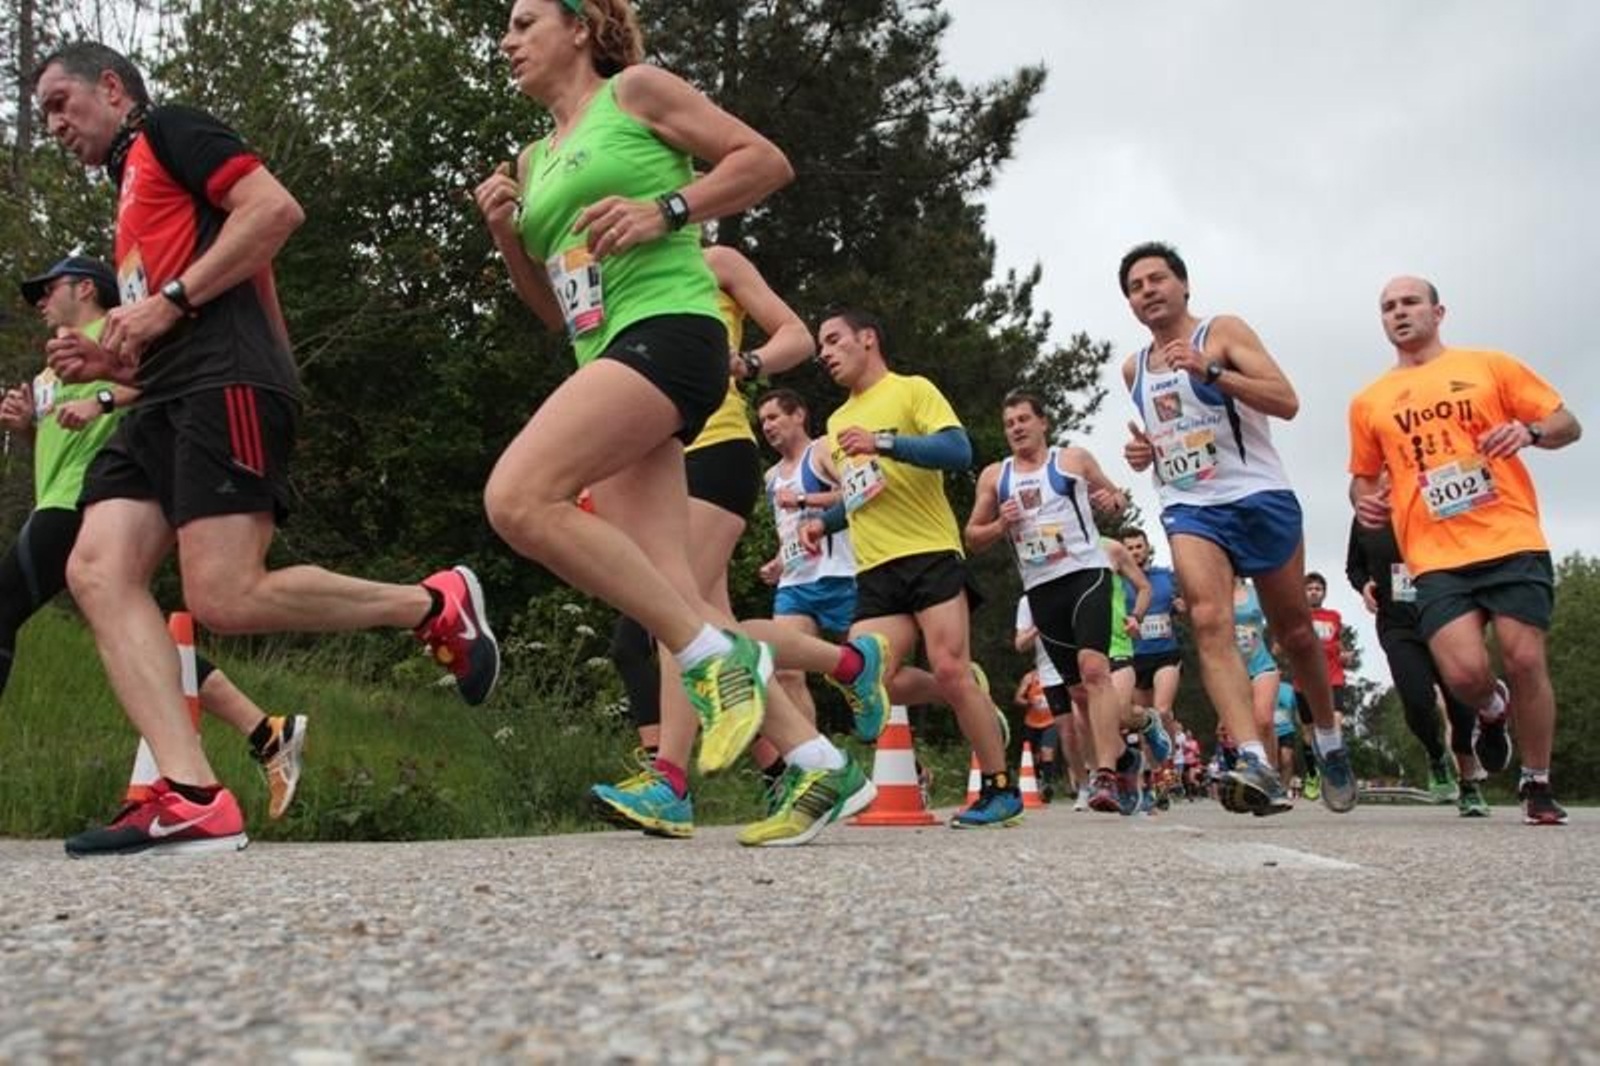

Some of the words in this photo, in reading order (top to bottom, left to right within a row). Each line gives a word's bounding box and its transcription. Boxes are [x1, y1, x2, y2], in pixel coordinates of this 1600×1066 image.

[1165, 451, 1200, 477] 707
[1429, 476, 1479, 506] 302
[1026, 540, 1047, 557] 74
